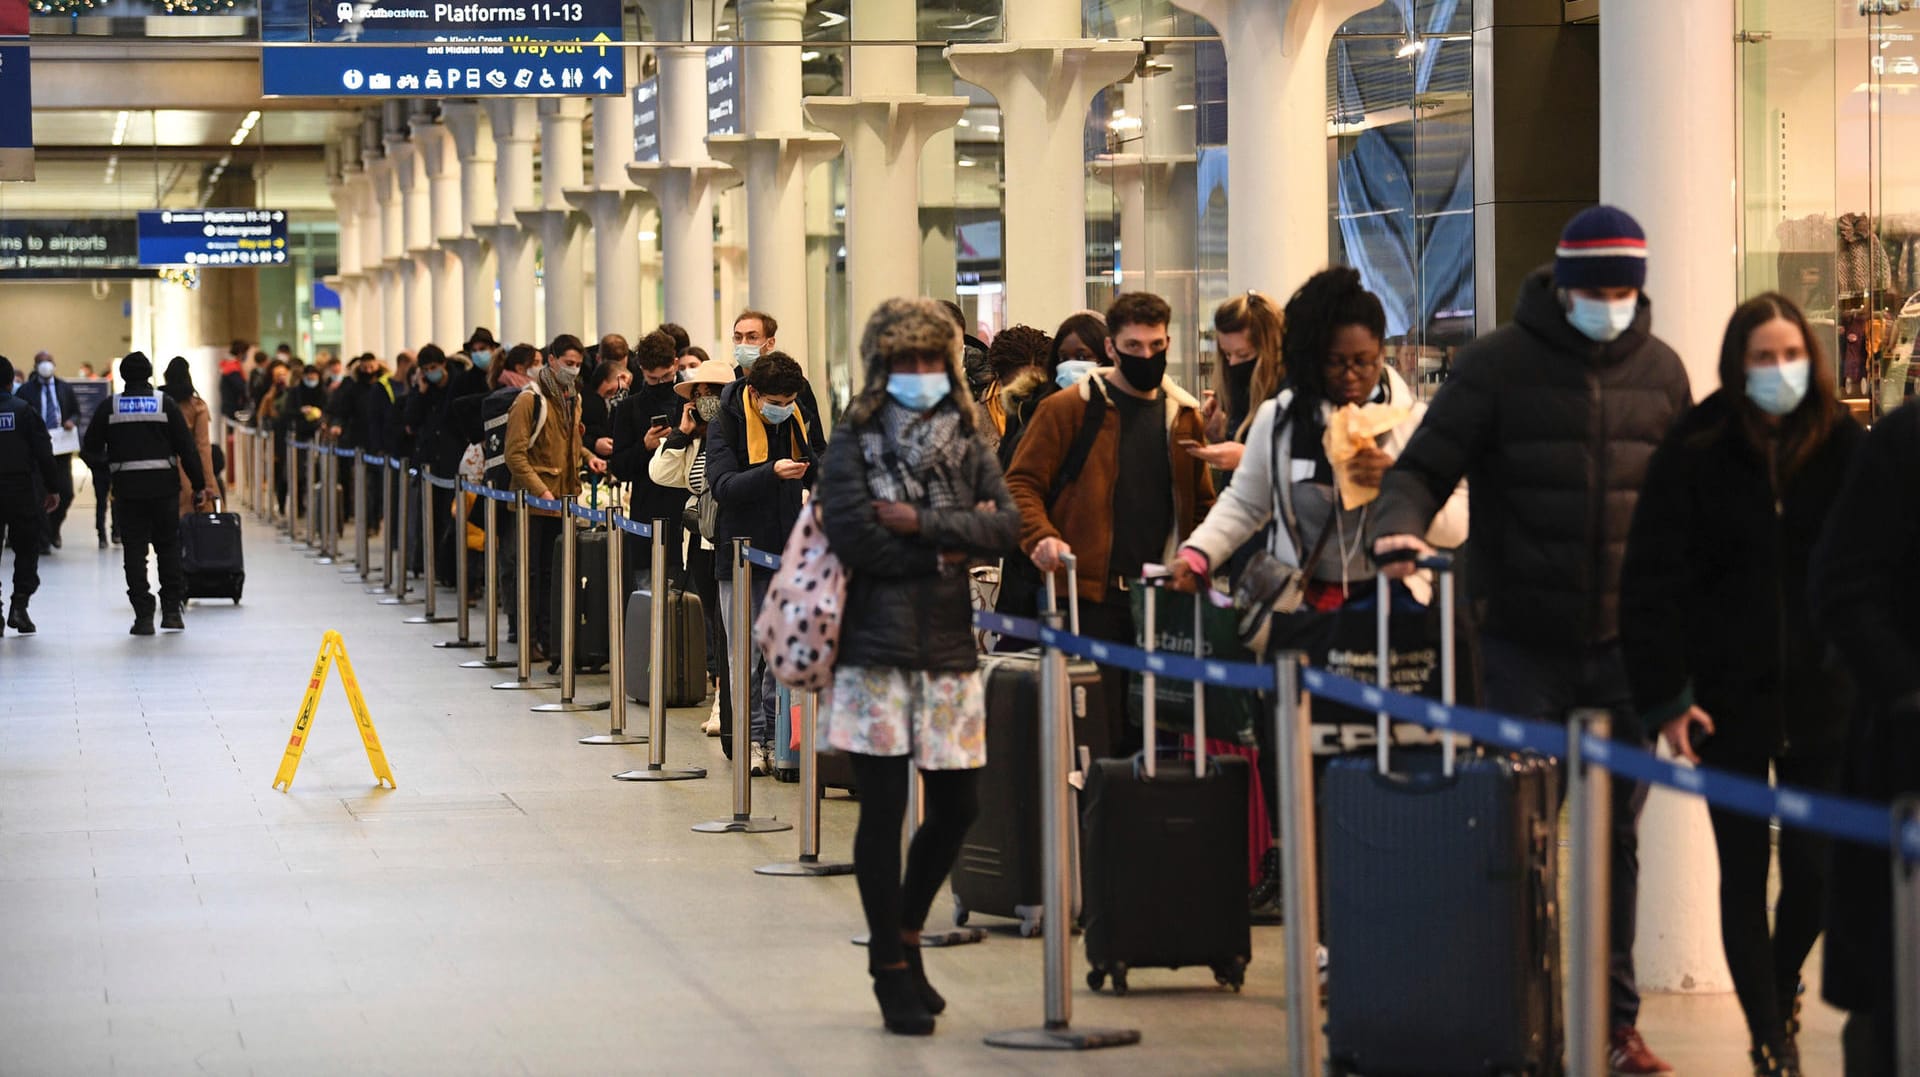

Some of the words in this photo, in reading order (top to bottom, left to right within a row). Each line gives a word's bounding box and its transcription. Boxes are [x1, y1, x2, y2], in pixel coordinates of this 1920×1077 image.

[434, 4, 526, 22] Platforms
[531, 4, 583, 21] 11-13
[427, 45, 443, 55] and
[445, 45, 480, 55] Midland
[482, 45, 504, 55] Road
[509, 36, 548, 57] Way
[553, 37, 583, 54] out
[27, 235, 43, 250] to
[49, 234, 107, 253] airports
